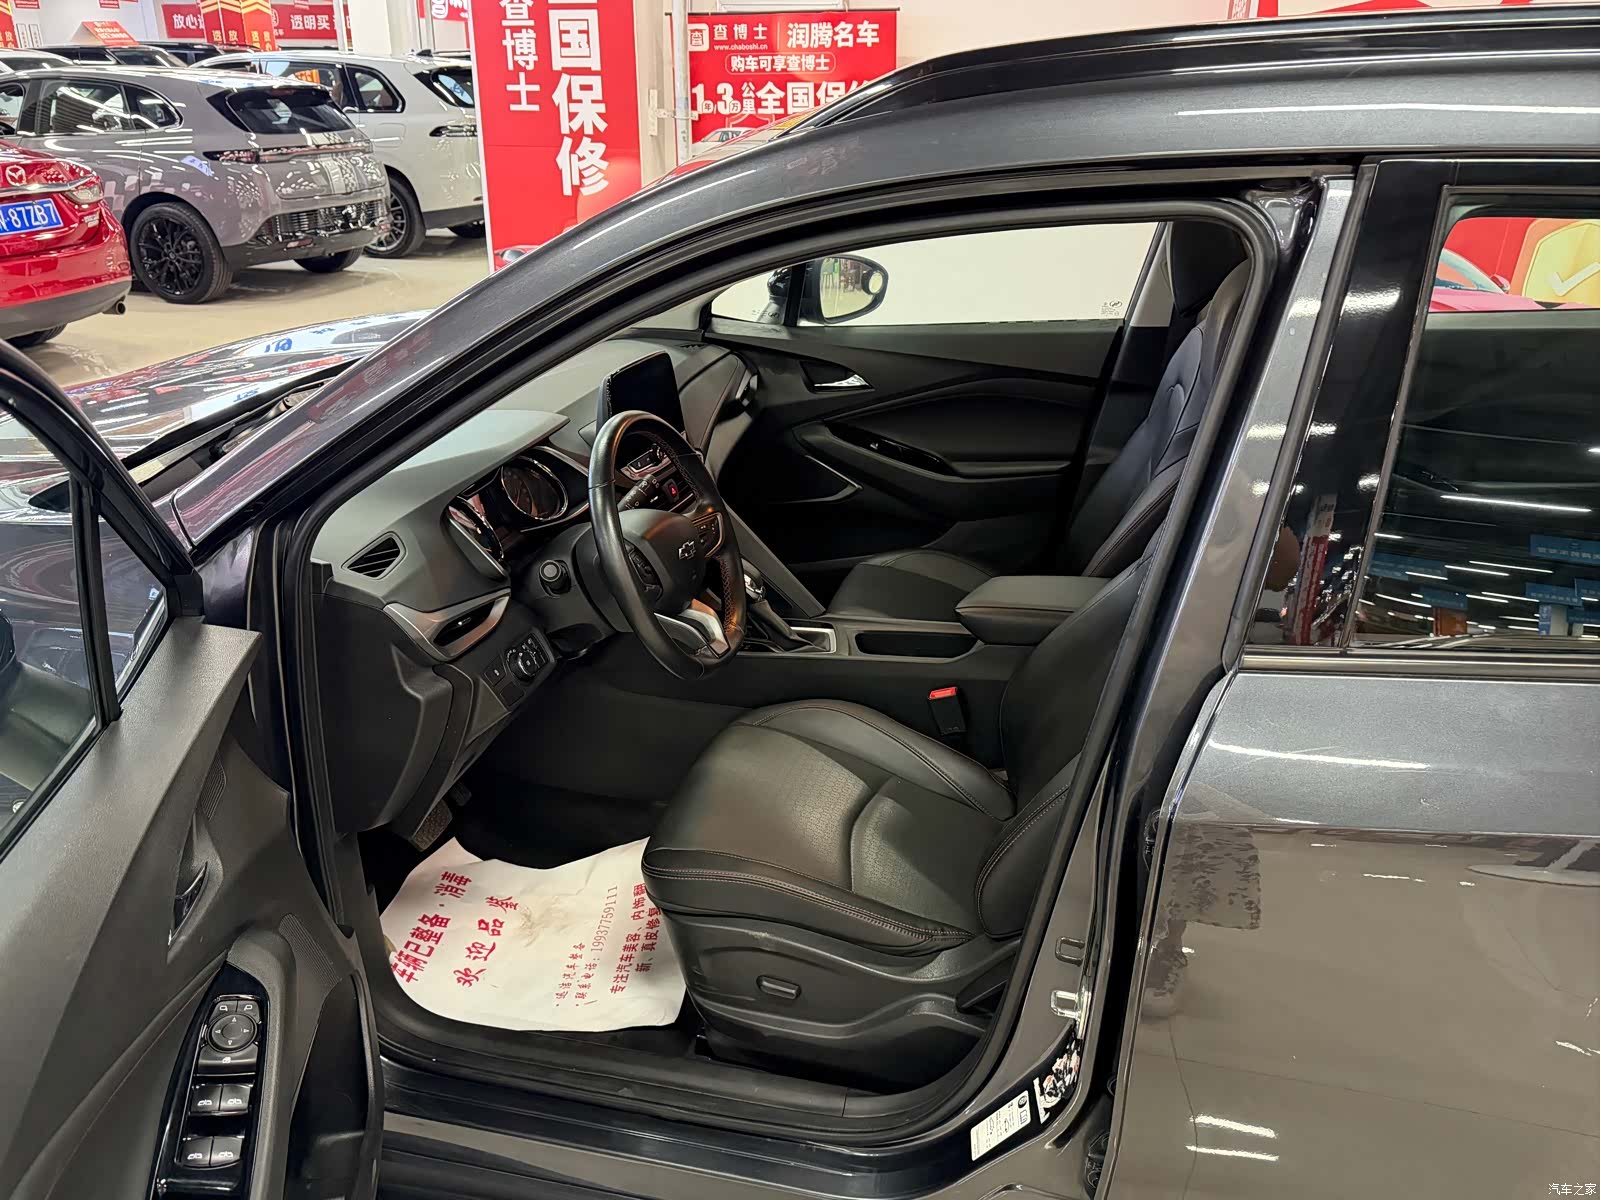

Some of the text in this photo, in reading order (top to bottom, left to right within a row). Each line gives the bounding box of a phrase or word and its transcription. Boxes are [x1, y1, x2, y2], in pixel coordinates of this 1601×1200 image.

[713, 23, 768, 41] 查博士
[787, 20, 880, 48] 润腾名车
[713, 43, 768, 51] www.chaboshi.cn
[730, 55, 830, 72] 购车可享查博士
[547, 0, 609, 196] 国保修
